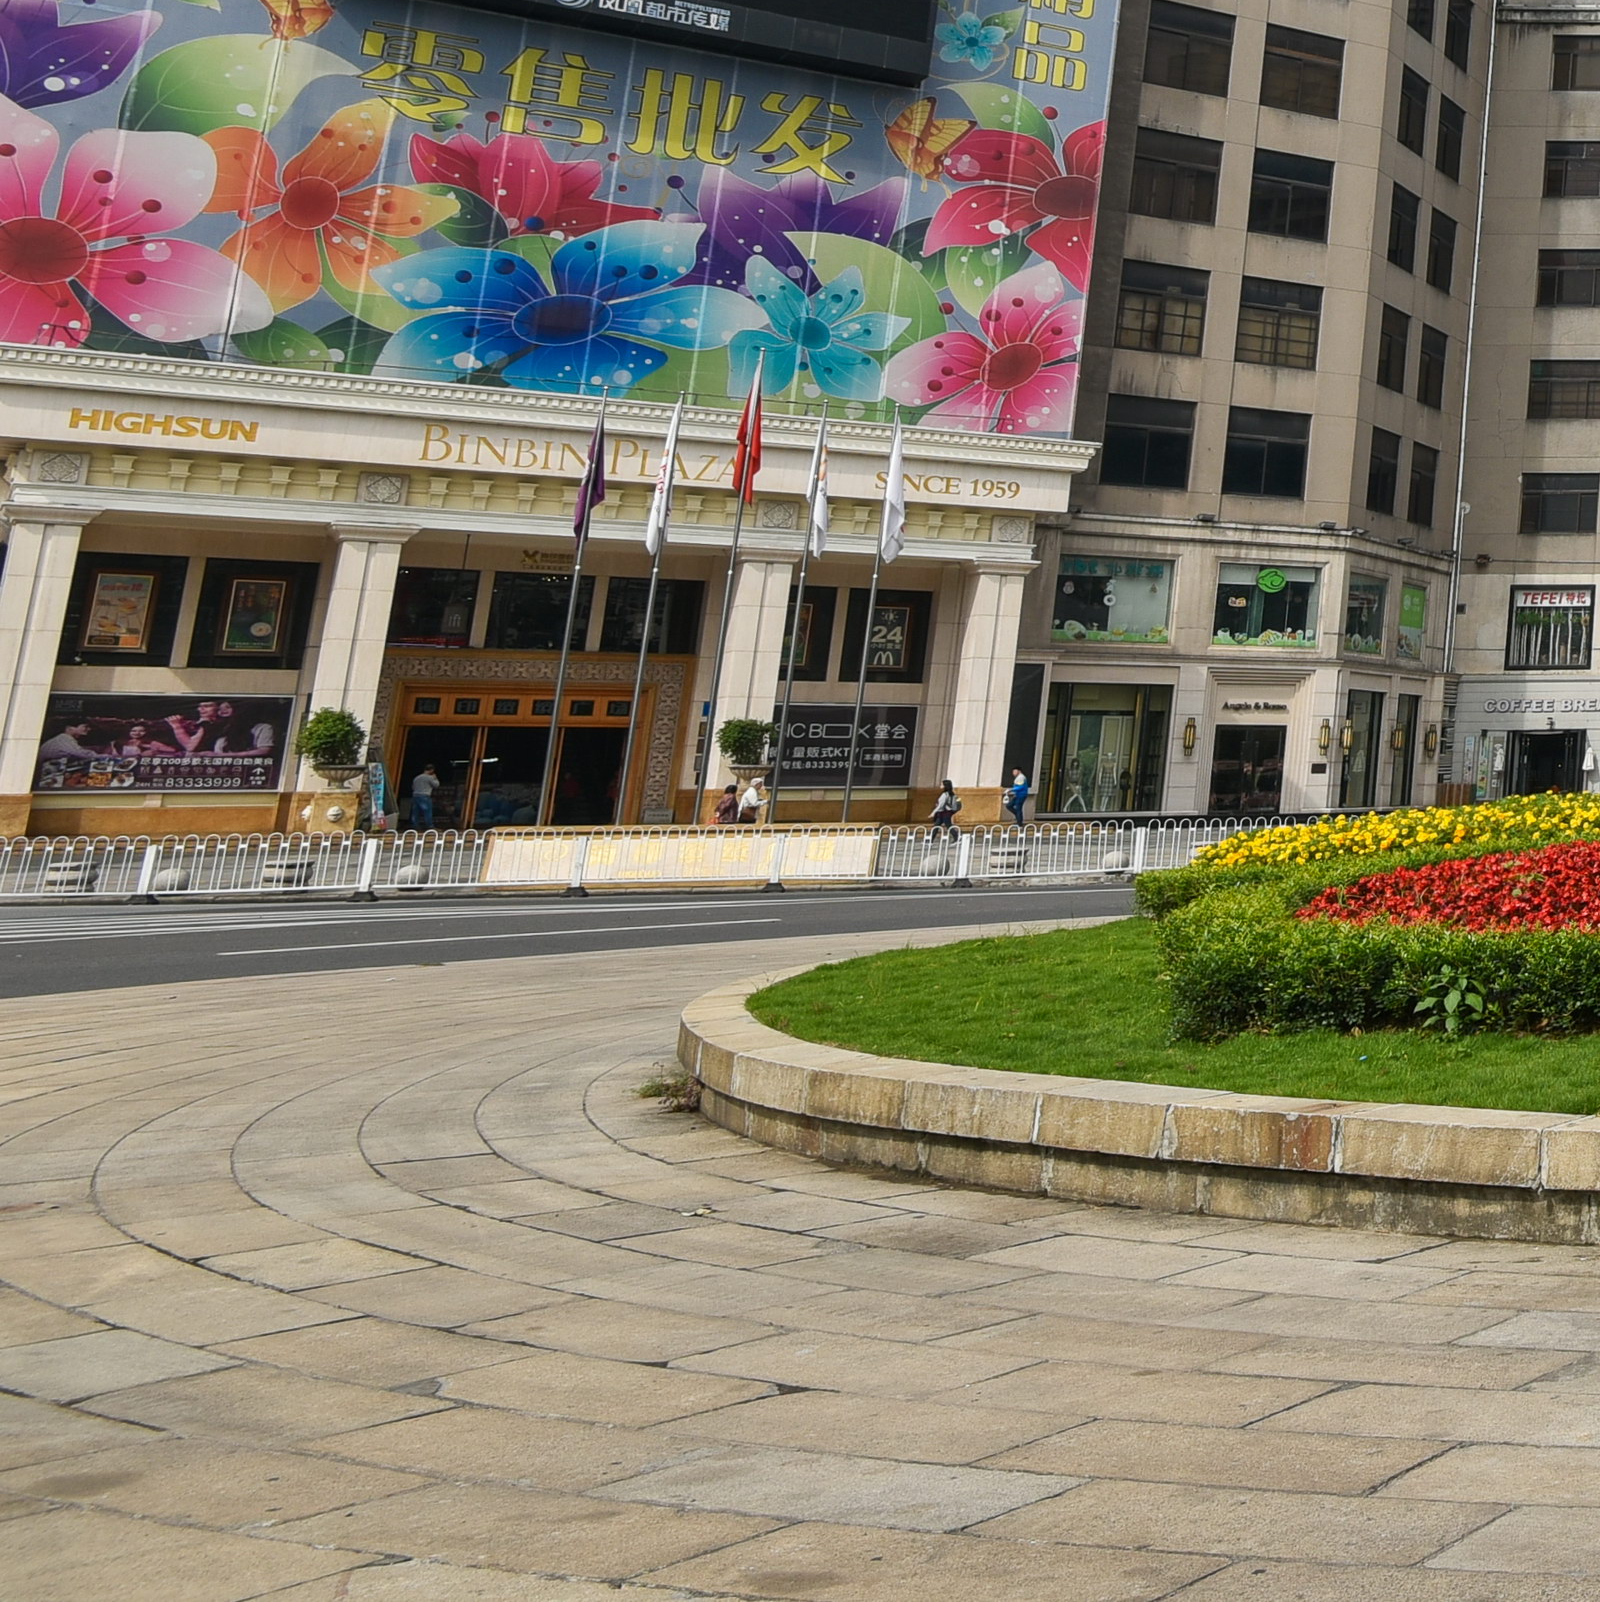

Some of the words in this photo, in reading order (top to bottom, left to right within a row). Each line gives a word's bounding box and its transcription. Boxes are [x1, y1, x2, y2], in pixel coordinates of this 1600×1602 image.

[359, 20, 864, 185] 零售批发
[69, 407, 259, 442] HIGHSUN
[875, 470, 961, 495] SNCE
[970, 478, 1020, 499] 1959
[1523, 592, 1563, 604] TEFEI
[871, 626, 903, 643] 24
[1484, 698, 1556, 713] COFFEE
[874, 723, 909, 739] 堂会
[165, 777, 241, 788] 83333999
